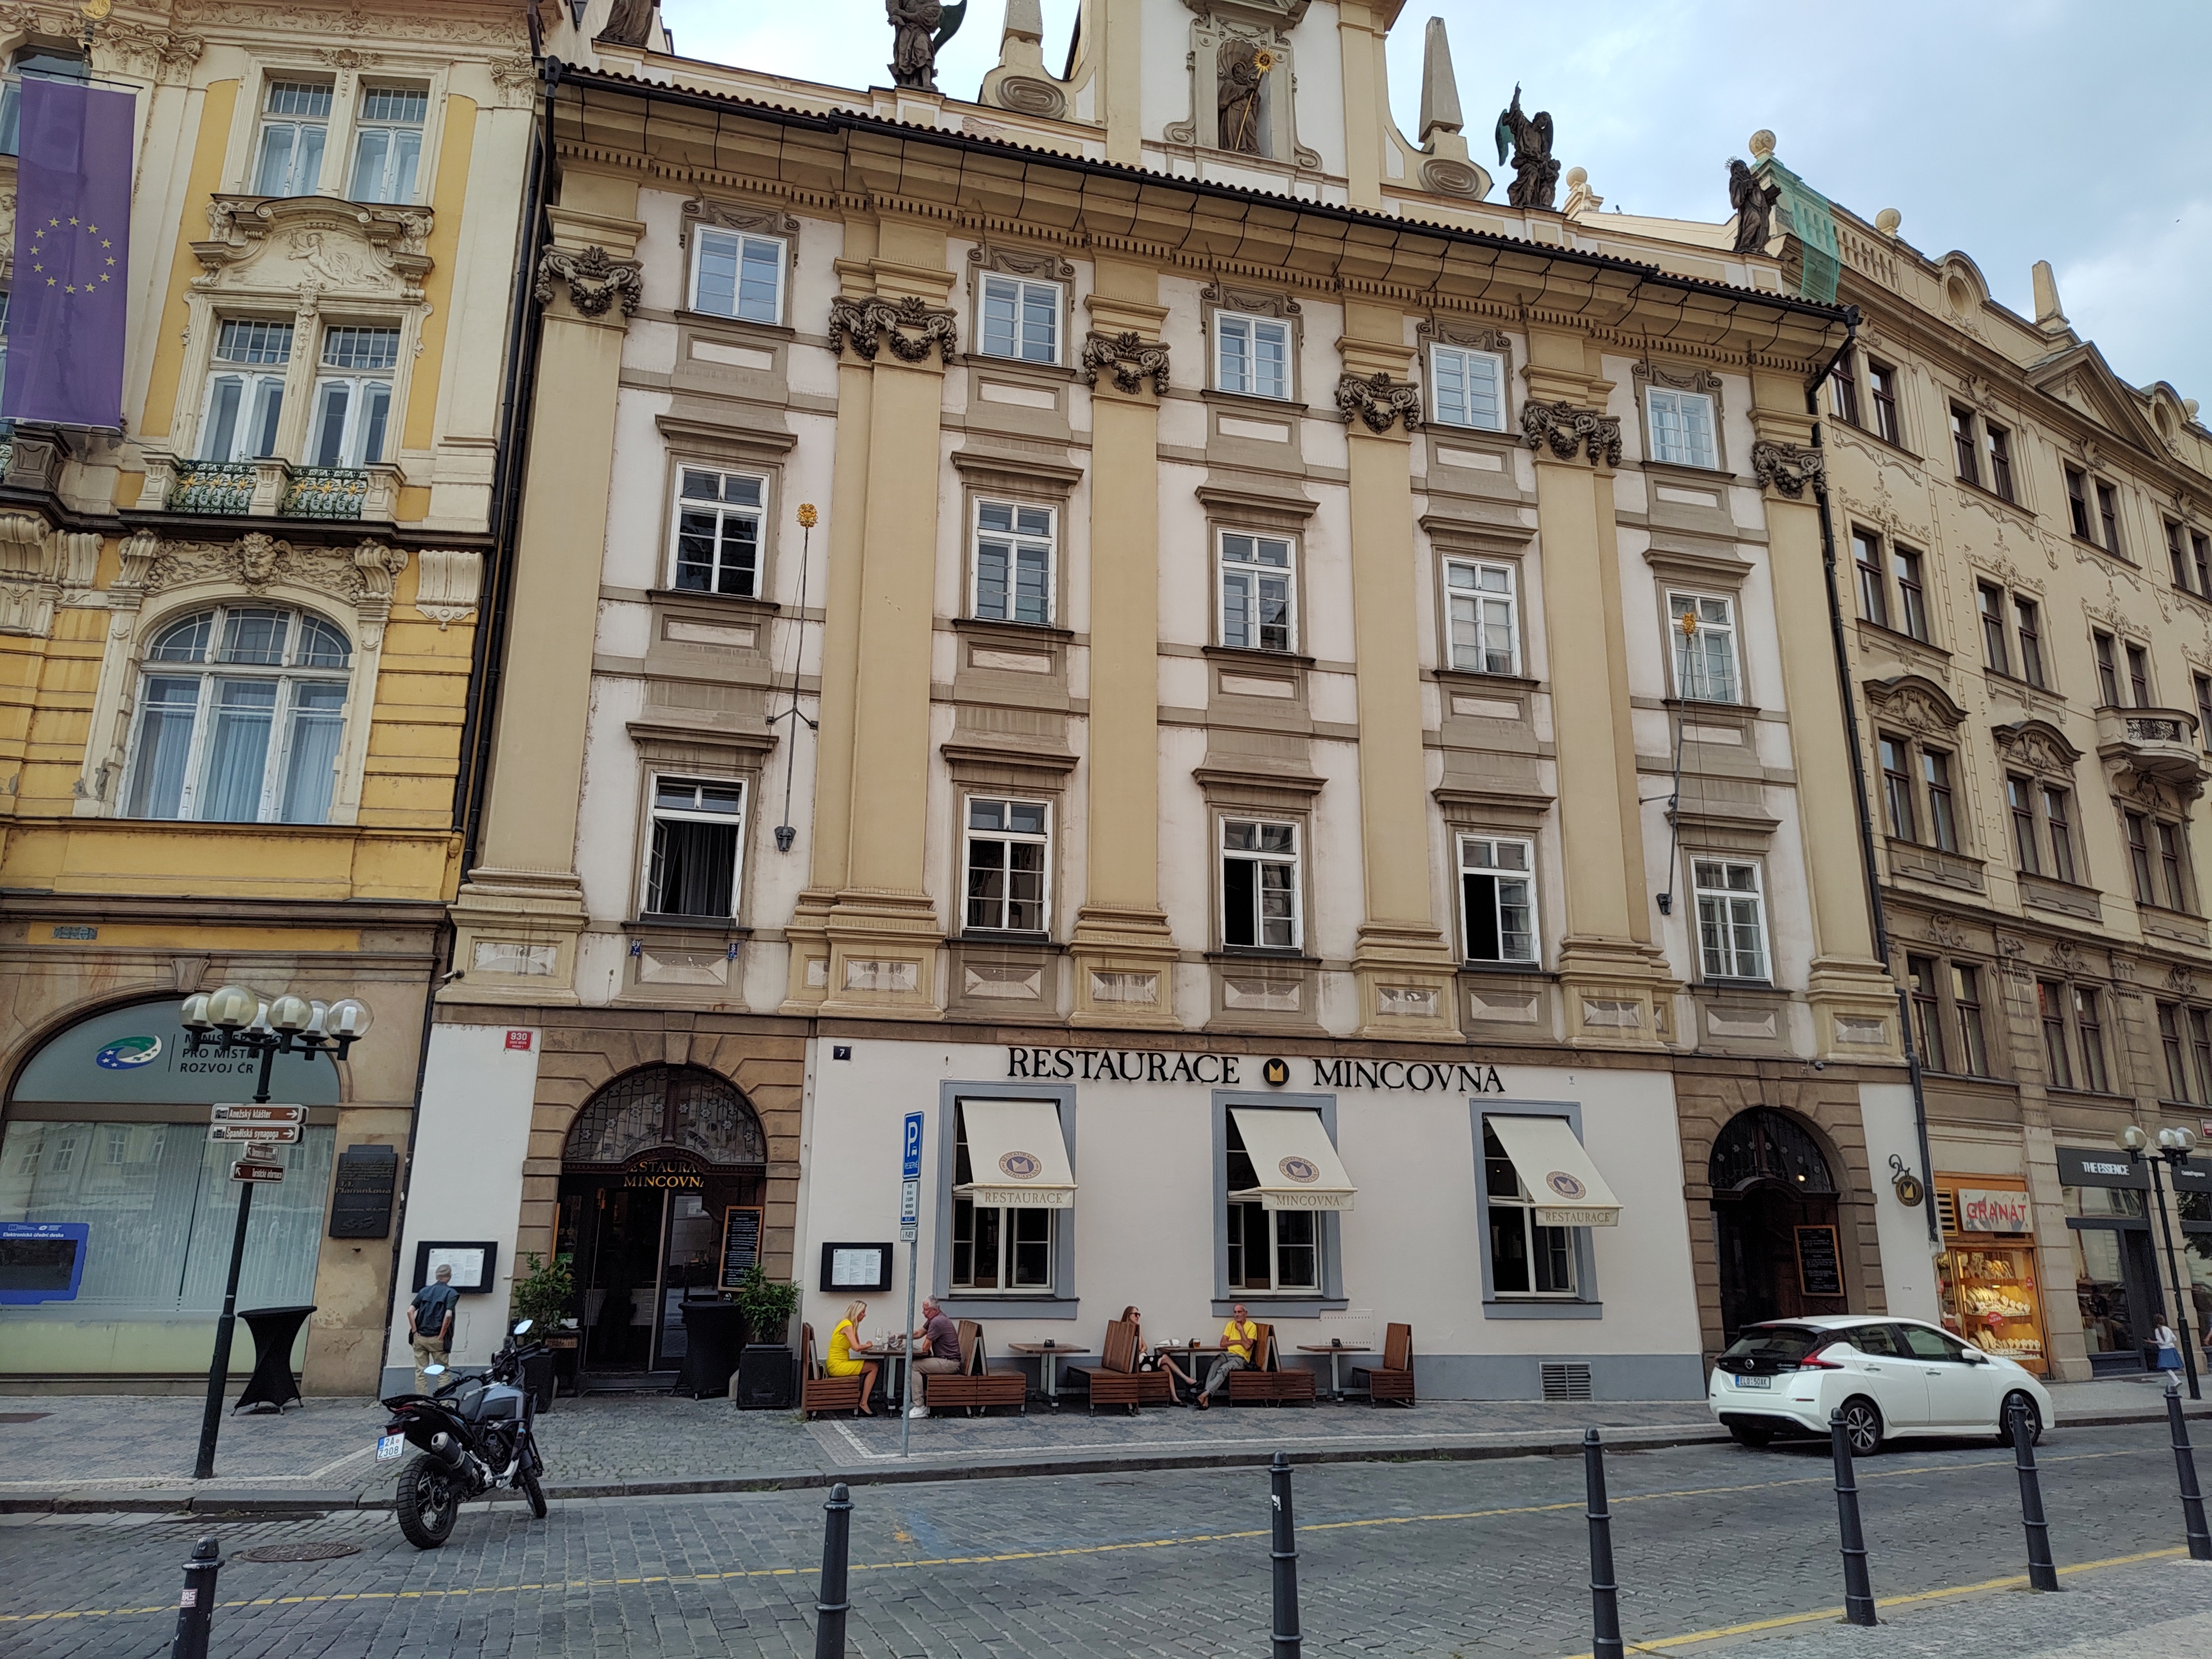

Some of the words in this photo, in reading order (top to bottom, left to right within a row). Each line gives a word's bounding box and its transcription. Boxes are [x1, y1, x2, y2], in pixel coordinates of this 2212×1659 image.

[510, 1032, 528, 1041] 930
[182, 1048, 209, 1058] PRO
[839, 1049, 845, 1057] 7
[180, 1063, 232, 1074] ROZVOJ
[238, 1062, 254, 1074] ČR
[1008, 1048, 1240, 1084] RESTAURACE
[1313, 1058, 1506, 1093] MINCOVNA
[229, 1109, 252, 1120] Anežský
[252, 1109, 272, 1118] klášter
[226, 1127, 253, 1139] Španělská
[254, 1131, 279, 1140] synagoga
[1001, 1152, 1037, 1163] RESTAURACE
[1004, 1169, 1039, 1178] MINCOVNA
[2081, 1162, 2098, 1174] THE
[2098, 1162, 2130, 1176] ESSENCE
[984, 1191, 1063, 1204] RESTAURACE
[1276, 1195, 1340, 1206] MINCOVNA
[1966, 1198, 2026, 1221] GRANÁT
[1545, 1211, 1610, 1223] RESTAURACE
[385, 1437, 394, 1447] 2A
[379, 1446, 399, 1458] Z308
